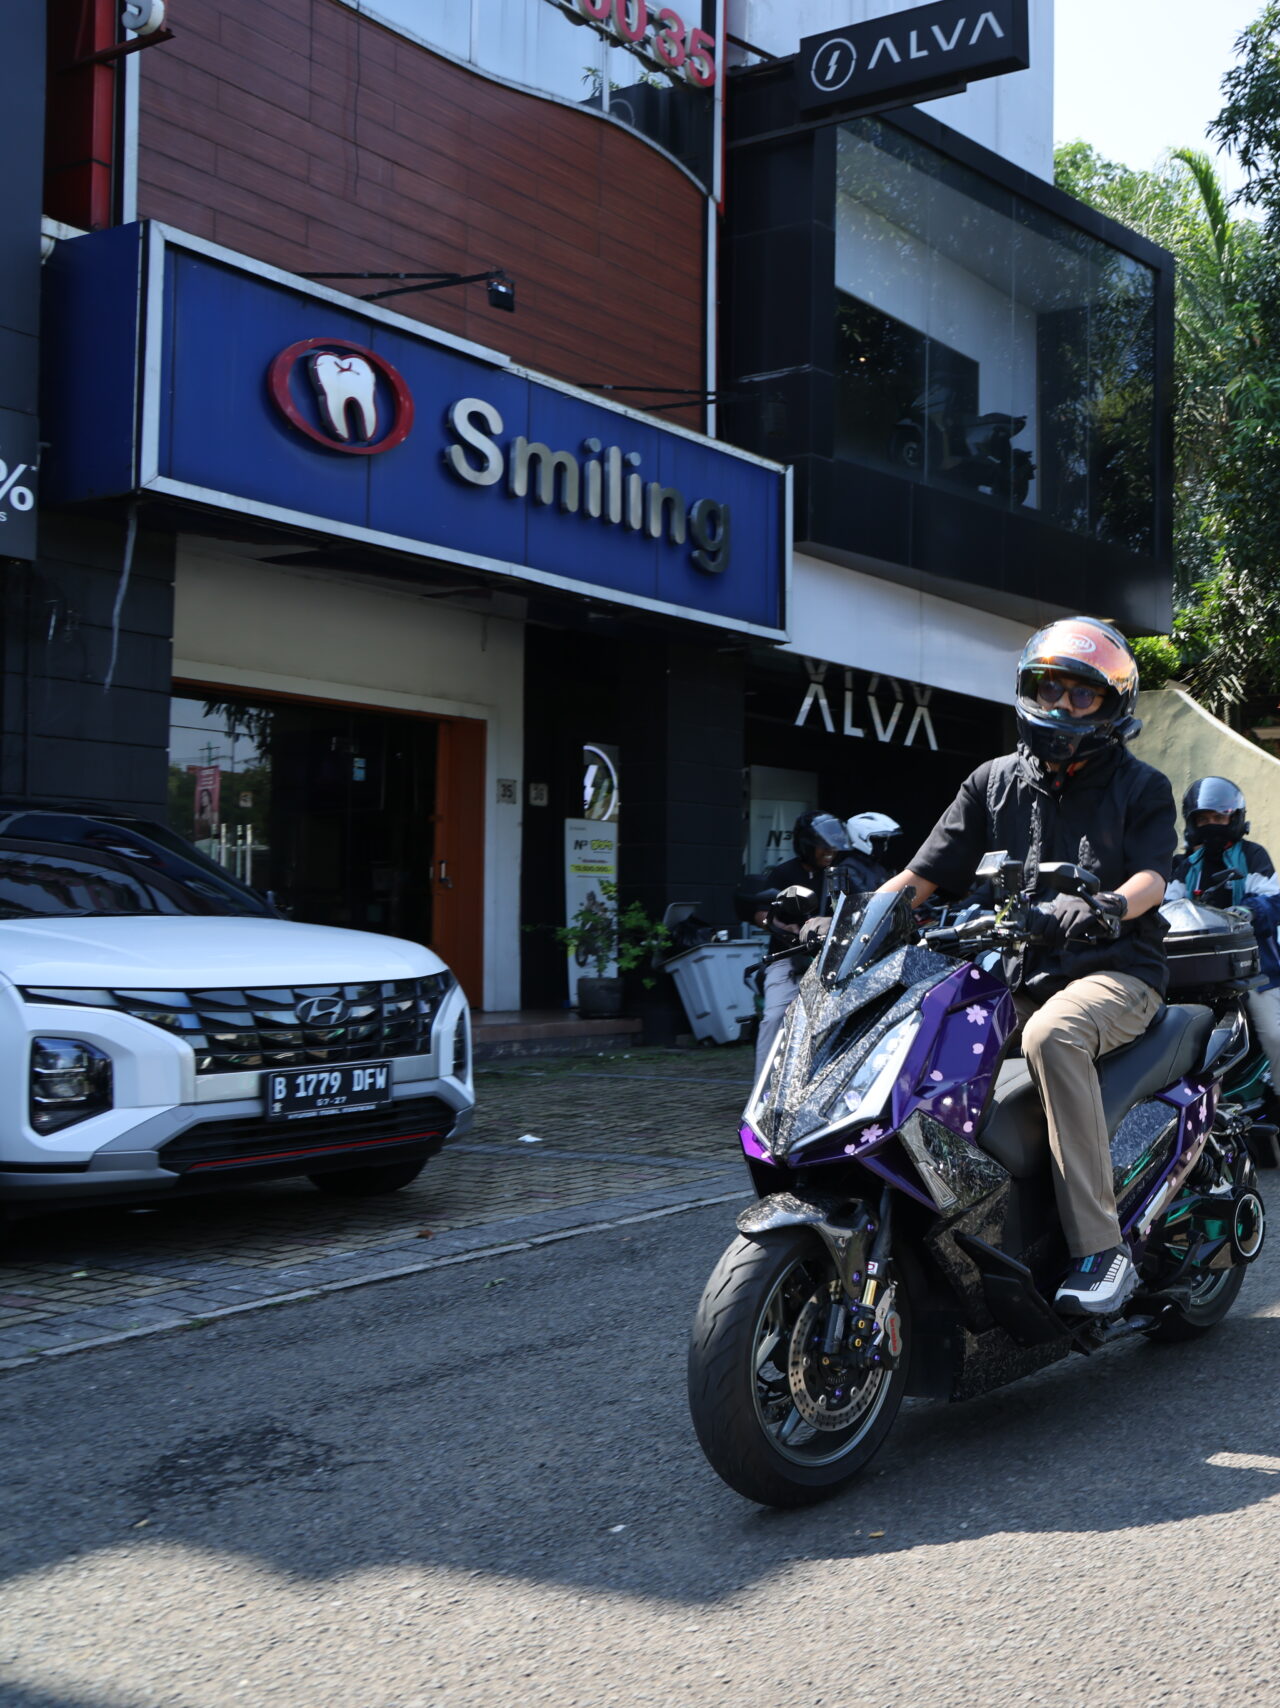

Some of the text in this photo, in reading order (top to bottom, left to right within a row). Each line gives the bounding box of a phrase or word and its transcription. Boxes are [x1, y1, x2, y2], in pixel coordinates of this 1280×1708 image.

[867, 11, 1004, 70] ALVA
[445, 397, 731, 573] Smiling
[794, 683, 938, 751] ALVA
[274, 1068, 387, 1100] B 1779 DFW
